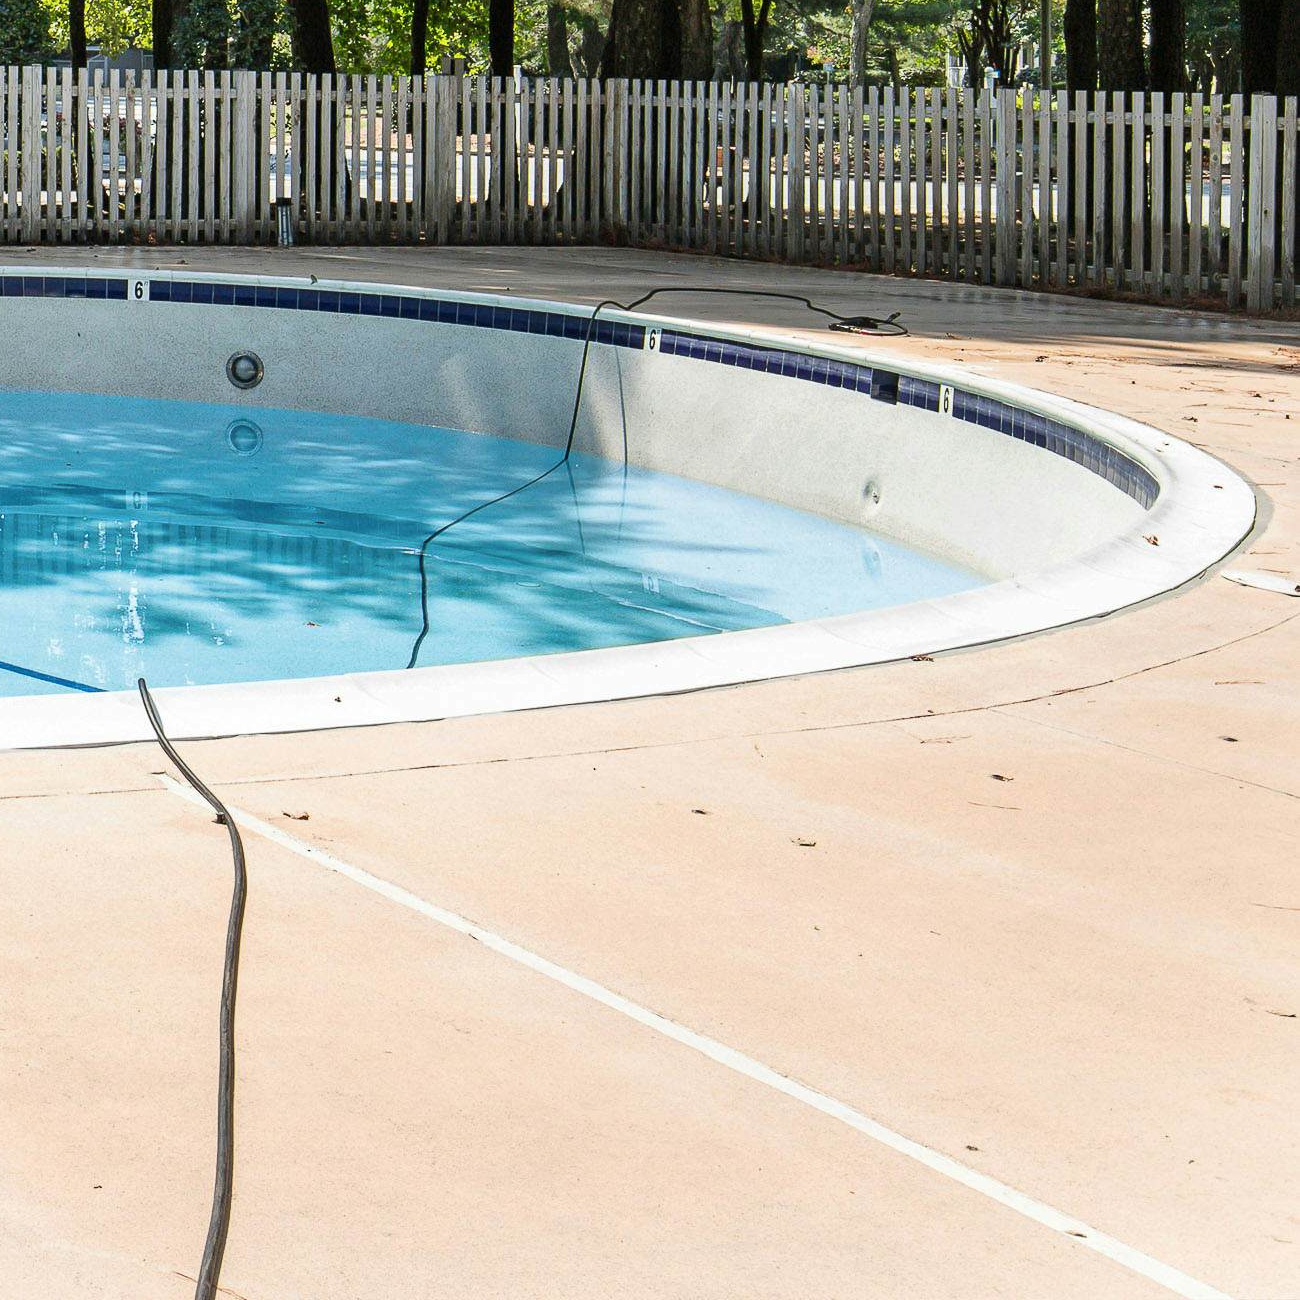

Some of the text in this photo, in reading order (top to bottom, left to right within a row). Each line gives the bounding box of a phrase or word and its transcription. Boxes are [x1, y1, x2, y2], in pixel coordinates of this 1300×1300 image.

[135, 281, 143, 299] 6
[649, 329, 657, 350] 6
[943, 387, 950, 413] 6
